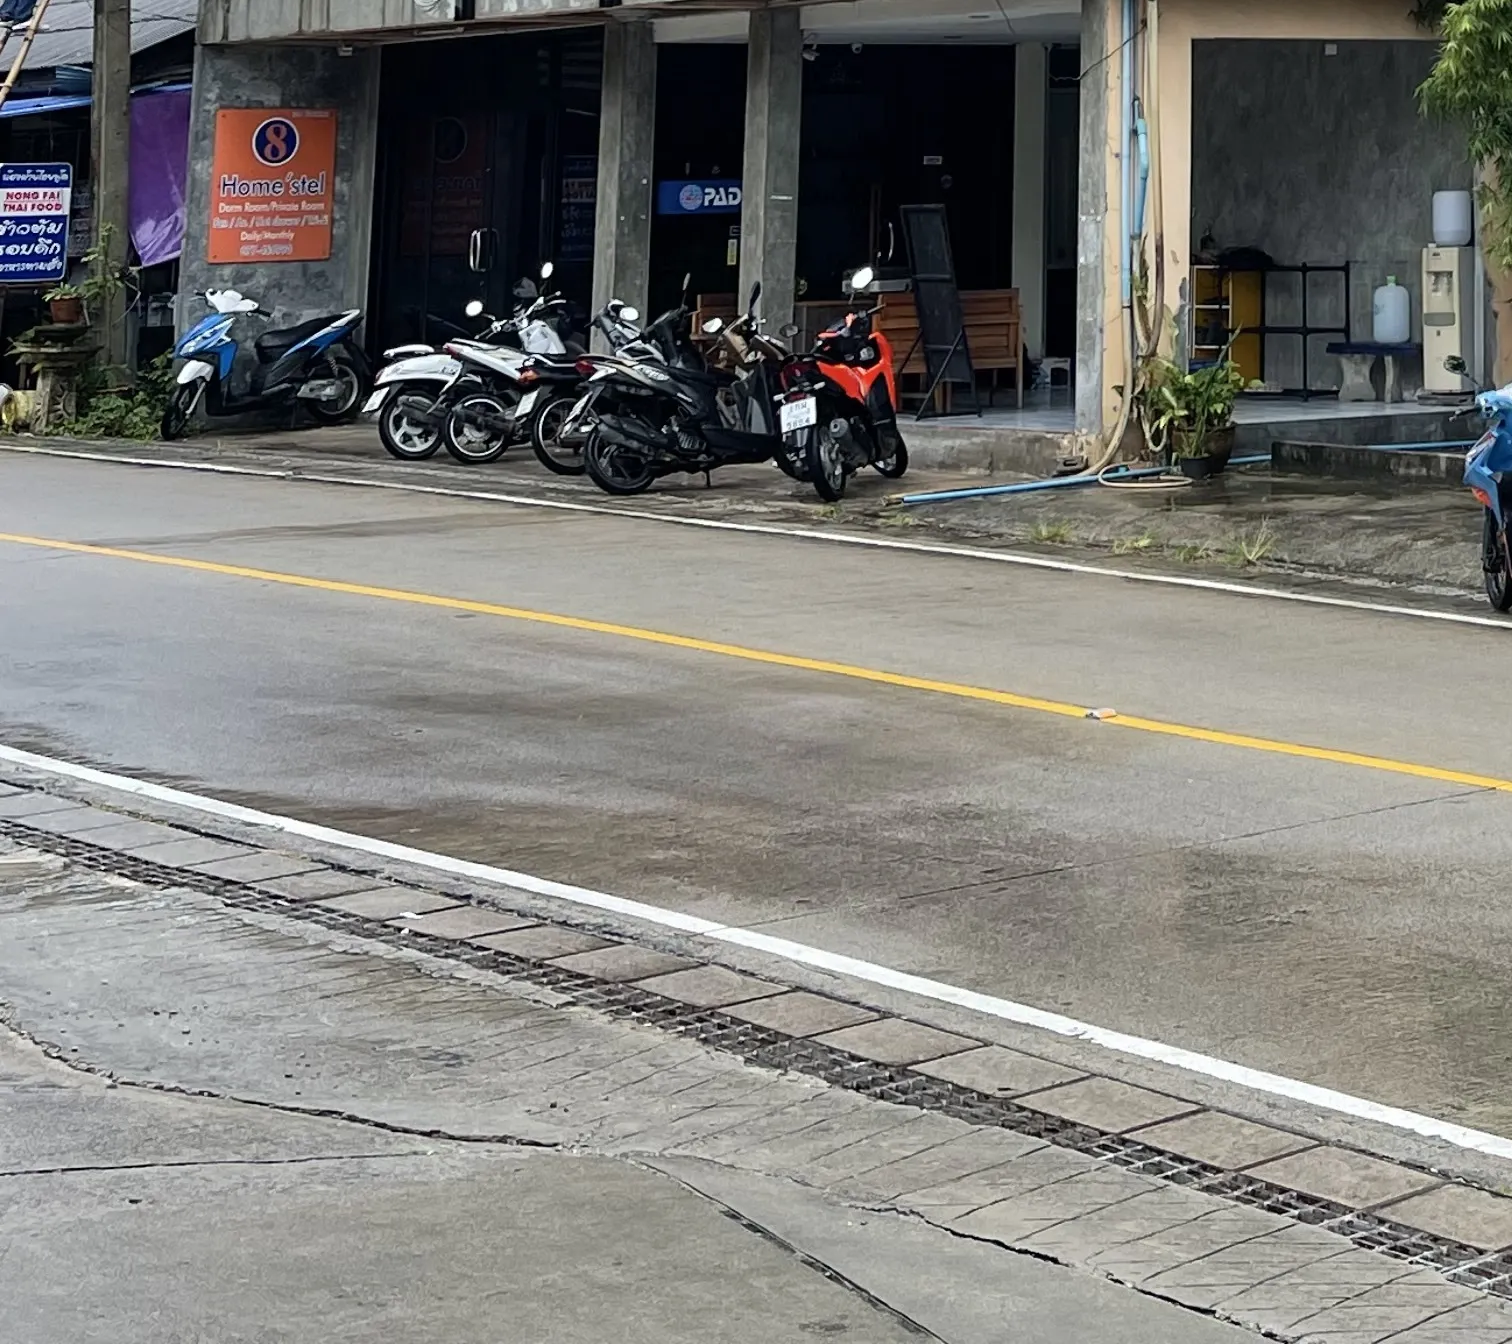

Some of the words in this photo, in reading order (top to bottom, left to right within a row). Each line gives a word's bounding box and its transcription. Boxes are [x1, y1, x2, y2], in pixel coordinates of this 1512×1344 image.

[264, 123, 287, 161] 8
[43, 192, 60, 200] FAI
[3, 203, 28, 212] THAI
[31, 203, 62, 211] FOOD
